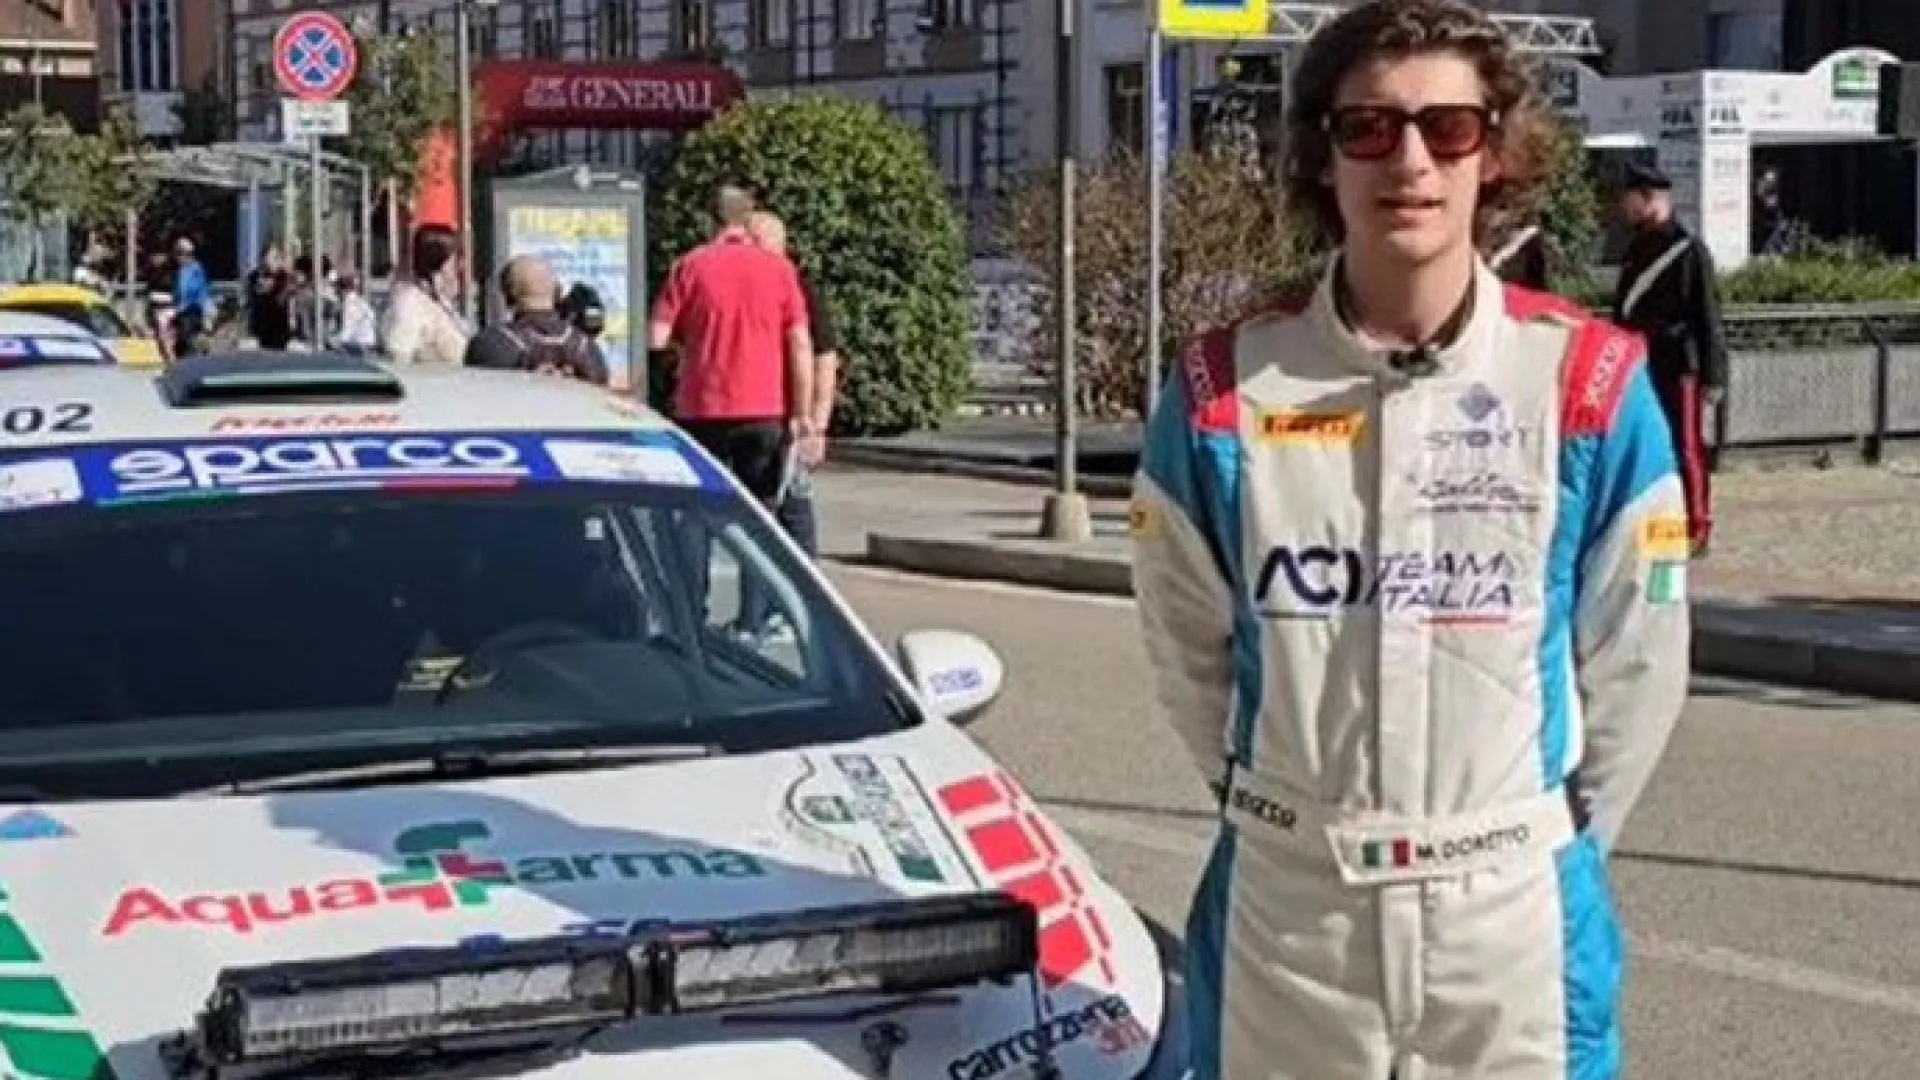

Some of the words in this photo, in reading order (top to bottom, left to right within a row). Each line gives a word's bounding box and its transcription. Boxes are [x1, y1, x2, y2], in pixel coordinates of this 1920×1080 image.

[569, 76, 712, 110] GENERALI
[3, 402, 93, 434] 02
[111, 437, 520, 490] sparco
